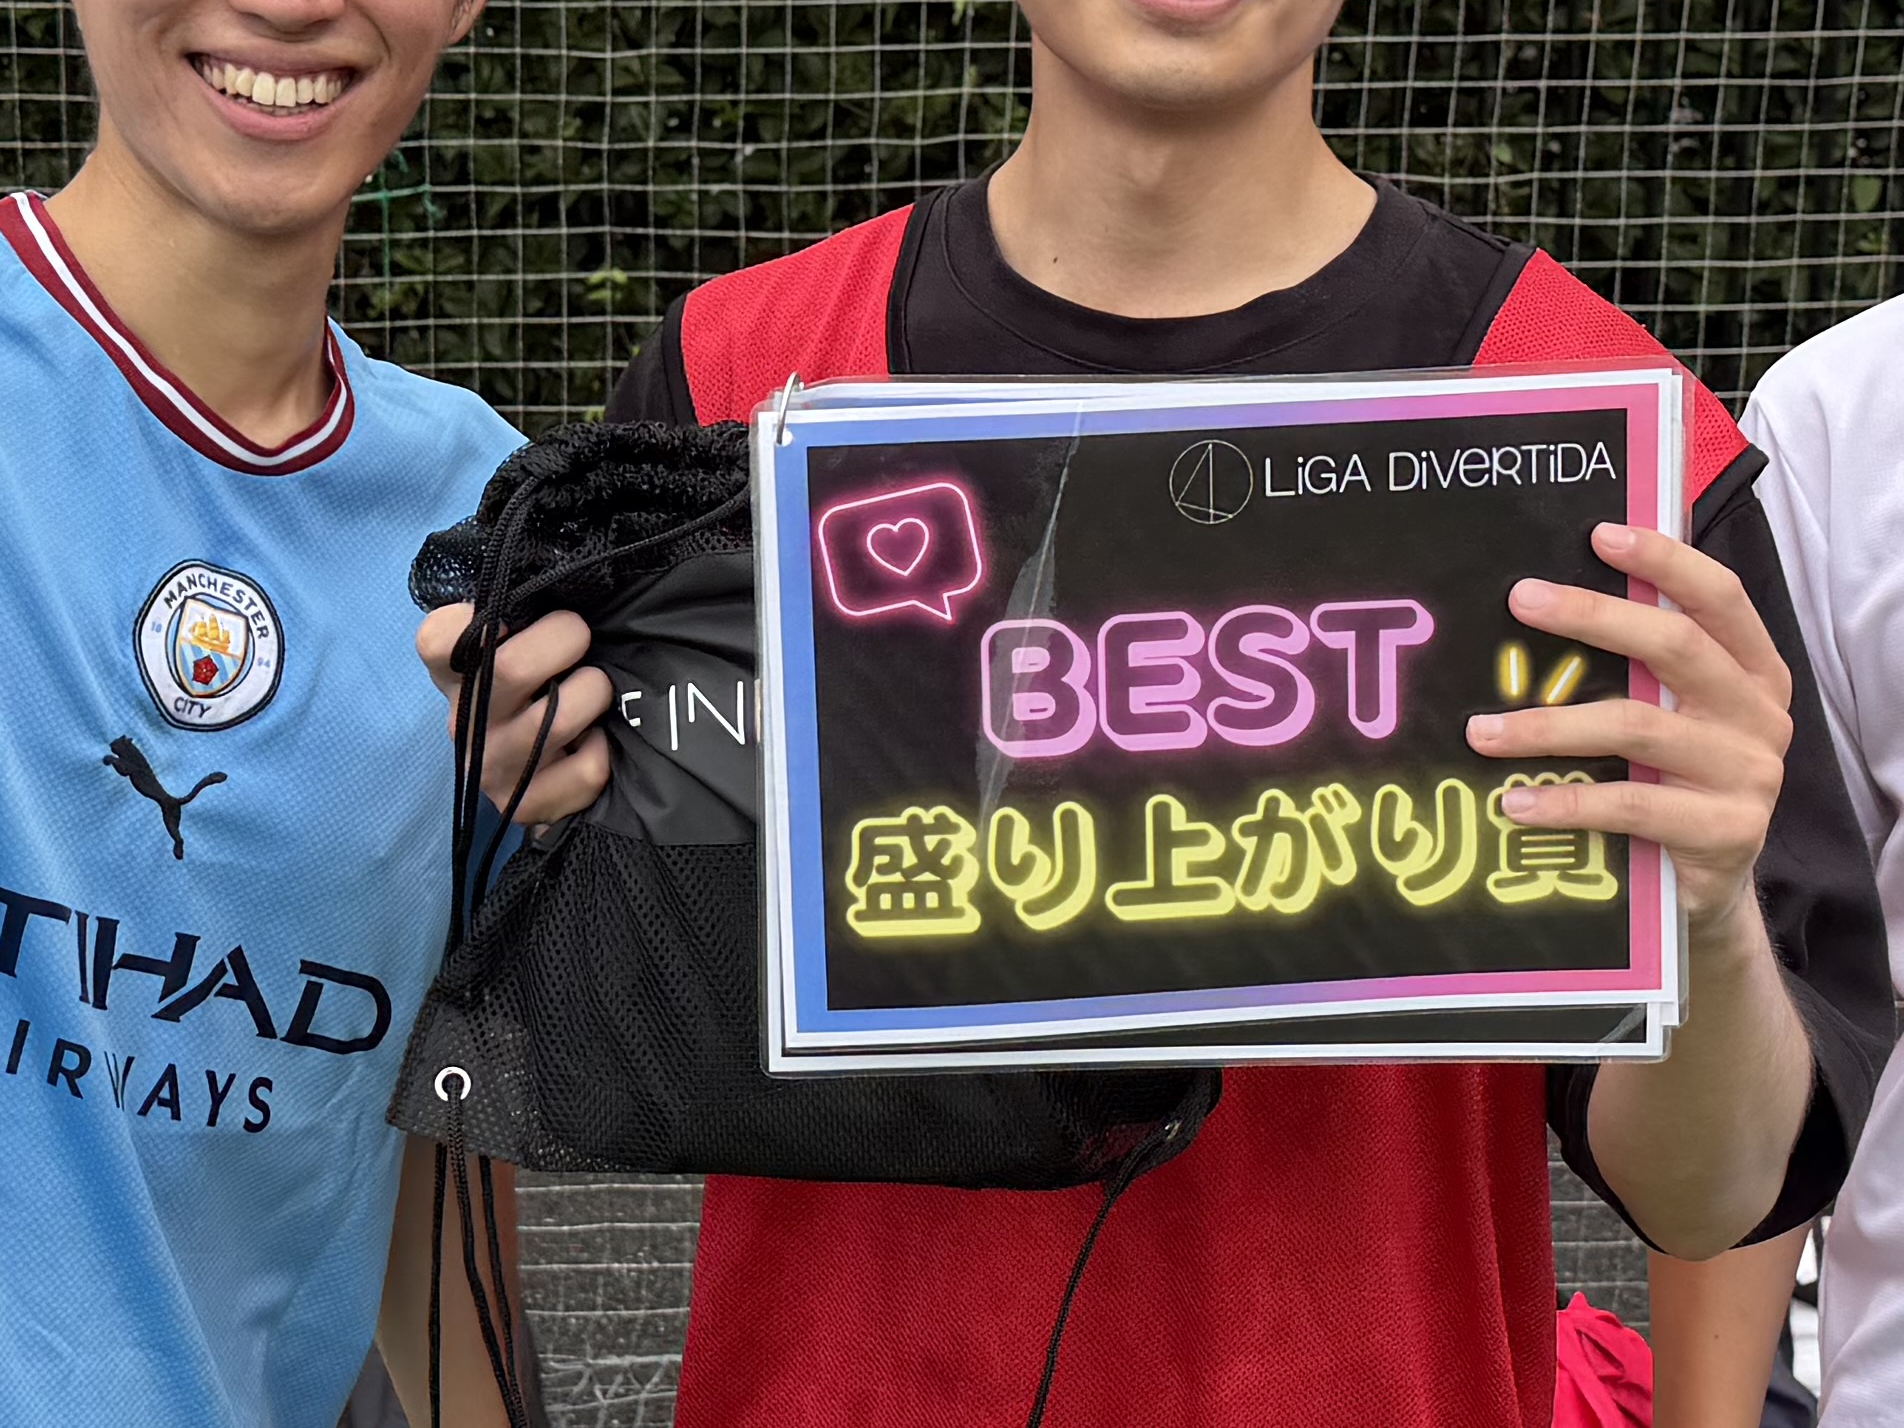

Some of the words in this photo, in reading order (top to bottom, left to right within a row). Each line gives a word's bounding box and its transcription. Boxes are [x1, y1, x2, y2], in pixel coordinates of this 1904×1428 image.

[163, 572, 270, 640] MANCHESTER
[173, 696, 212, 719] CITY
[980, 598, 1436, 759] BEST
[844, 770, 1620, 938] 盛り上がり賞
